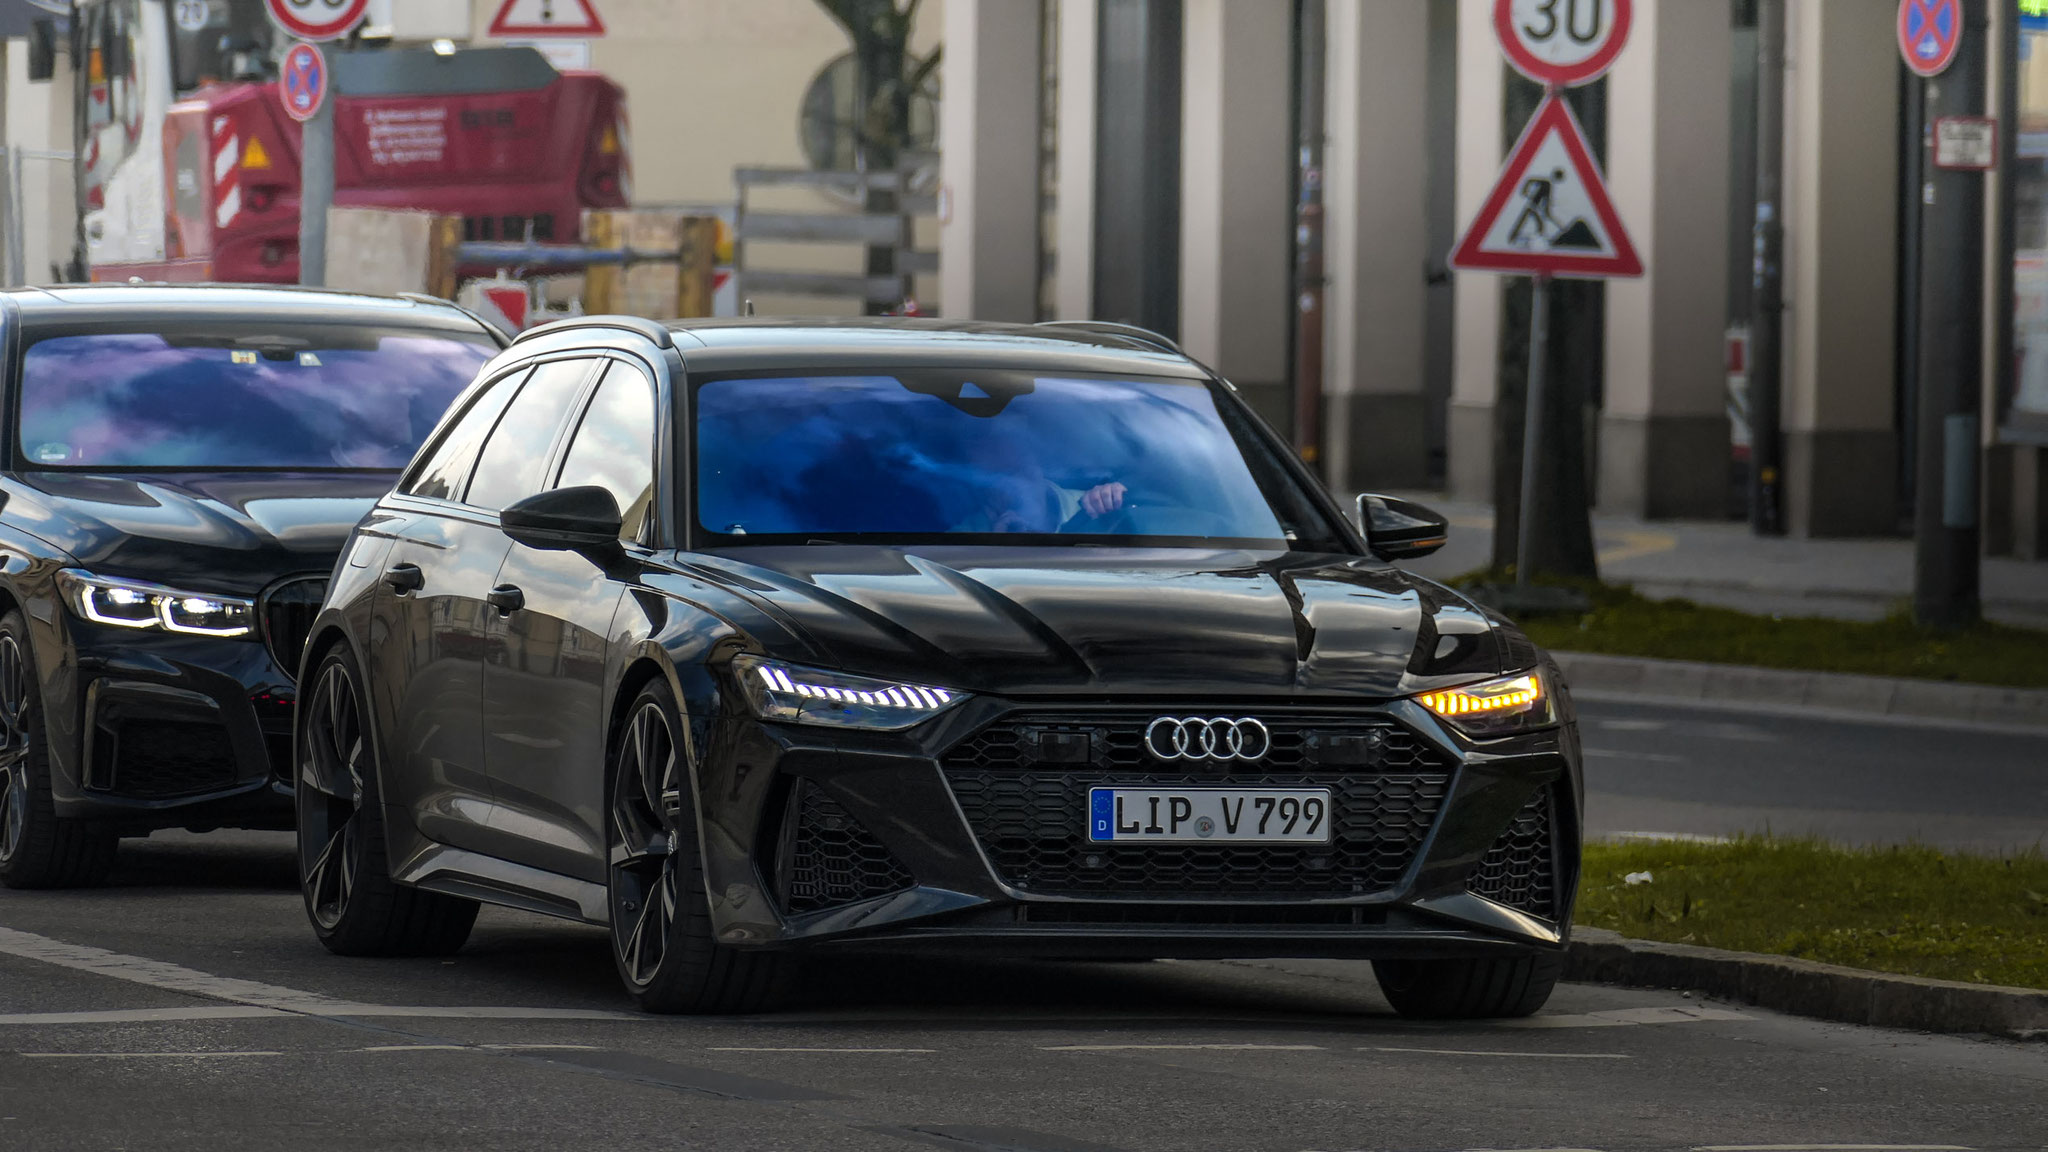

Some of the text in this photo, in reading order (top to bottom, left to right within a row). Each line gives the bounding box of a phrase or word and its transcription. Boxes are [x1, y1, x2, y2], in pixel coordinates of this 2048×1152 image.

[1523, 0, 1602, 44] 30
[1098, 820, 1107, 831] D
[1116, 796, 1192, 834] LIP
[1254, 797, 1324, 835] 799
